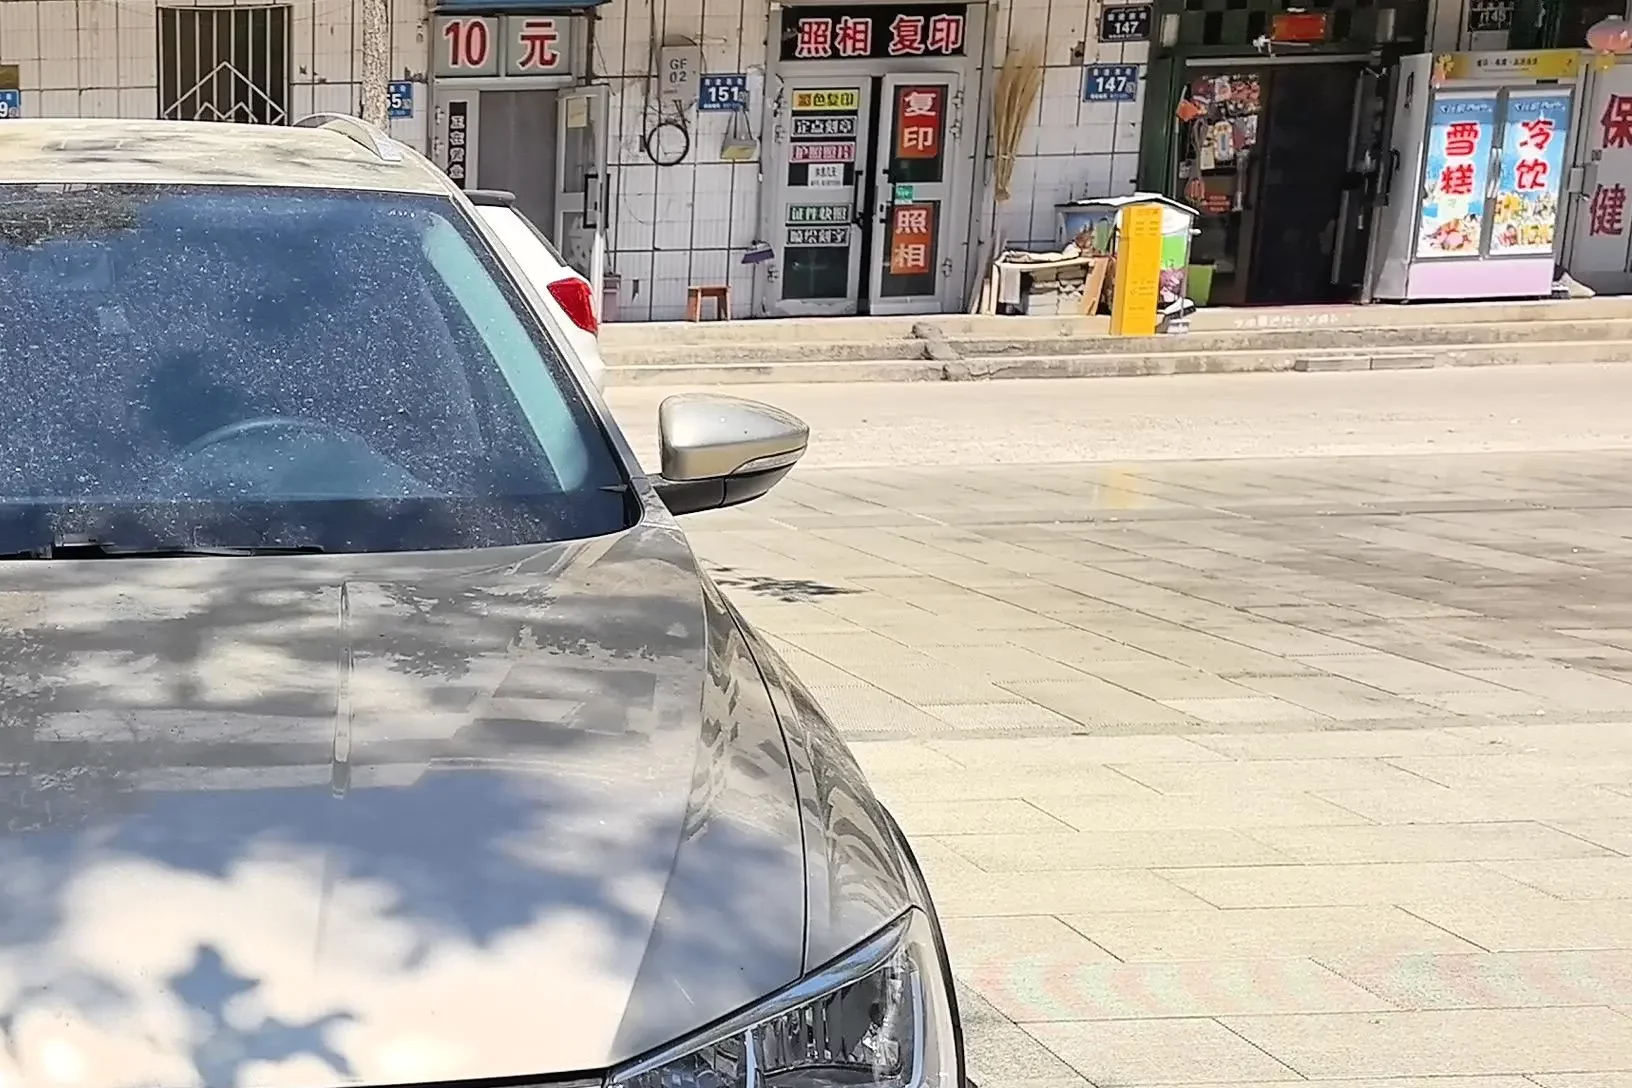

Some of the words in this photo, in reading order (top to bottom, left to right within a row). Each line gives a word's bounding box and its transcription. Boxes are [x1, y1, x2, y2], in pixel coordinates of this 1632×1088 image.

[443, 18, 490, 68] 10
[517, 18, 560, 70] 元
[796, 16, 872, 57] 照相
[888, 14, 964, 55] 复印
[1114, 21, 1139, 34] 147
[669, 58, 687, 69] GF
[670, 71, 687, 83] 02
[1096, 77, 1127, 92] 147
[708, 86, 739, 102] 151
[903, 91, 937, 150] 复印
[1439, 120, 1482, 196] 雪糕
[1515, 117, 1555, 191] 冷饮
[895, 209, 927, 268] 照相
